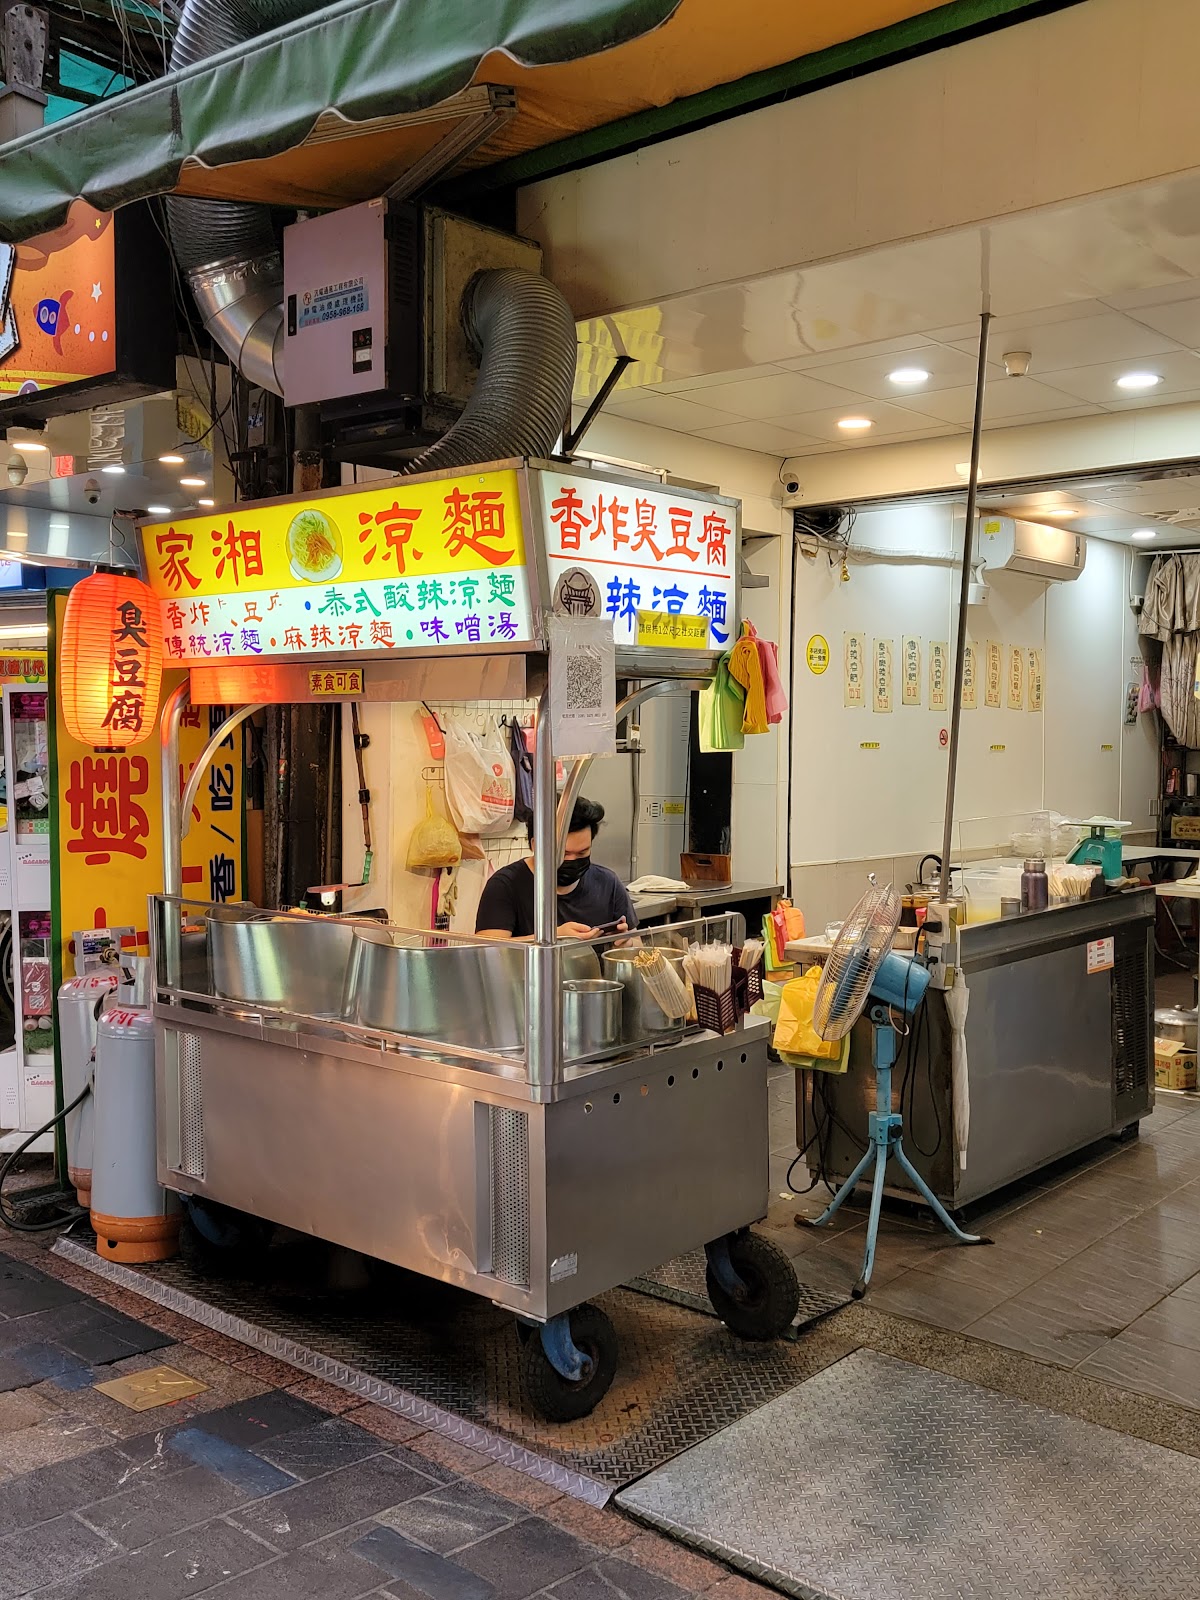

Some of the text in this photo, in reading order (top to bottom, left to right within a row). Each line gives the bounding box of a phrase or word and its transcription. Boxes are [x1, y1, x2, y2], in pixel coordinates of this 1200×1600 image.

[550, 487, 731, 567] 香炸臭豆腐
[166, 572, 516, 630] 香炸豆 泰式酸辣涼麵
[164, 612, 519, 659] 傳統涼麵 麻辣涼麵 味噌湯
[102, 601, 149, 732] 臭豆腐
[311, 671, 361, 692] 素食可食
